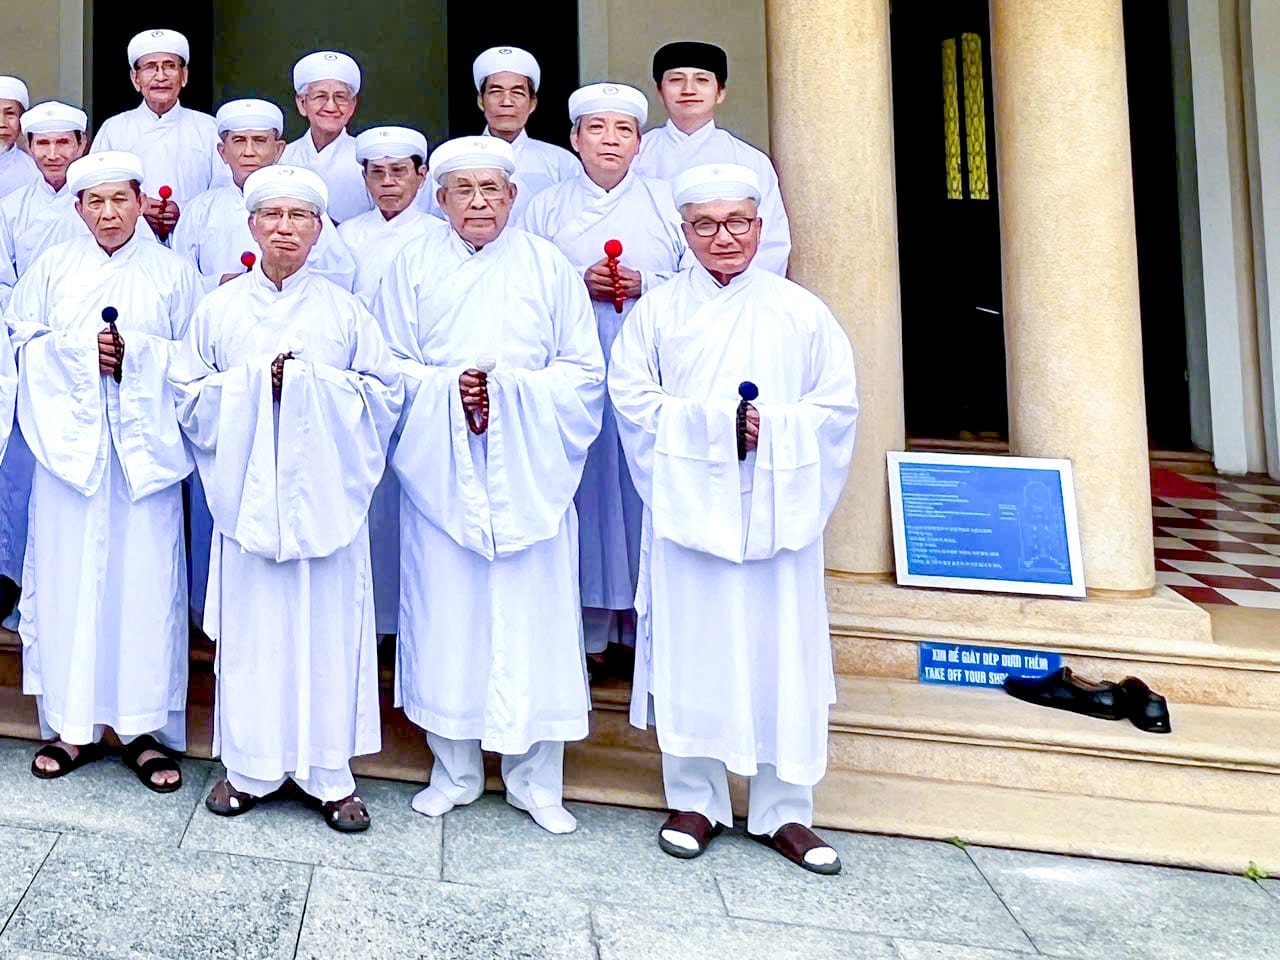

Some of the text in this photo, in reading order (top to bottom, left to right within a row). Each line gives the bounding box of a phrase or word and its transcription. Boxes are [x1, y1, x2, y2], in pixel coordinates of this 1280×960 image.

[924, 666, 945, 681] TAKE
[947, 668, 962, 682] OFF
[964, 669, 986, 684] YOUR
